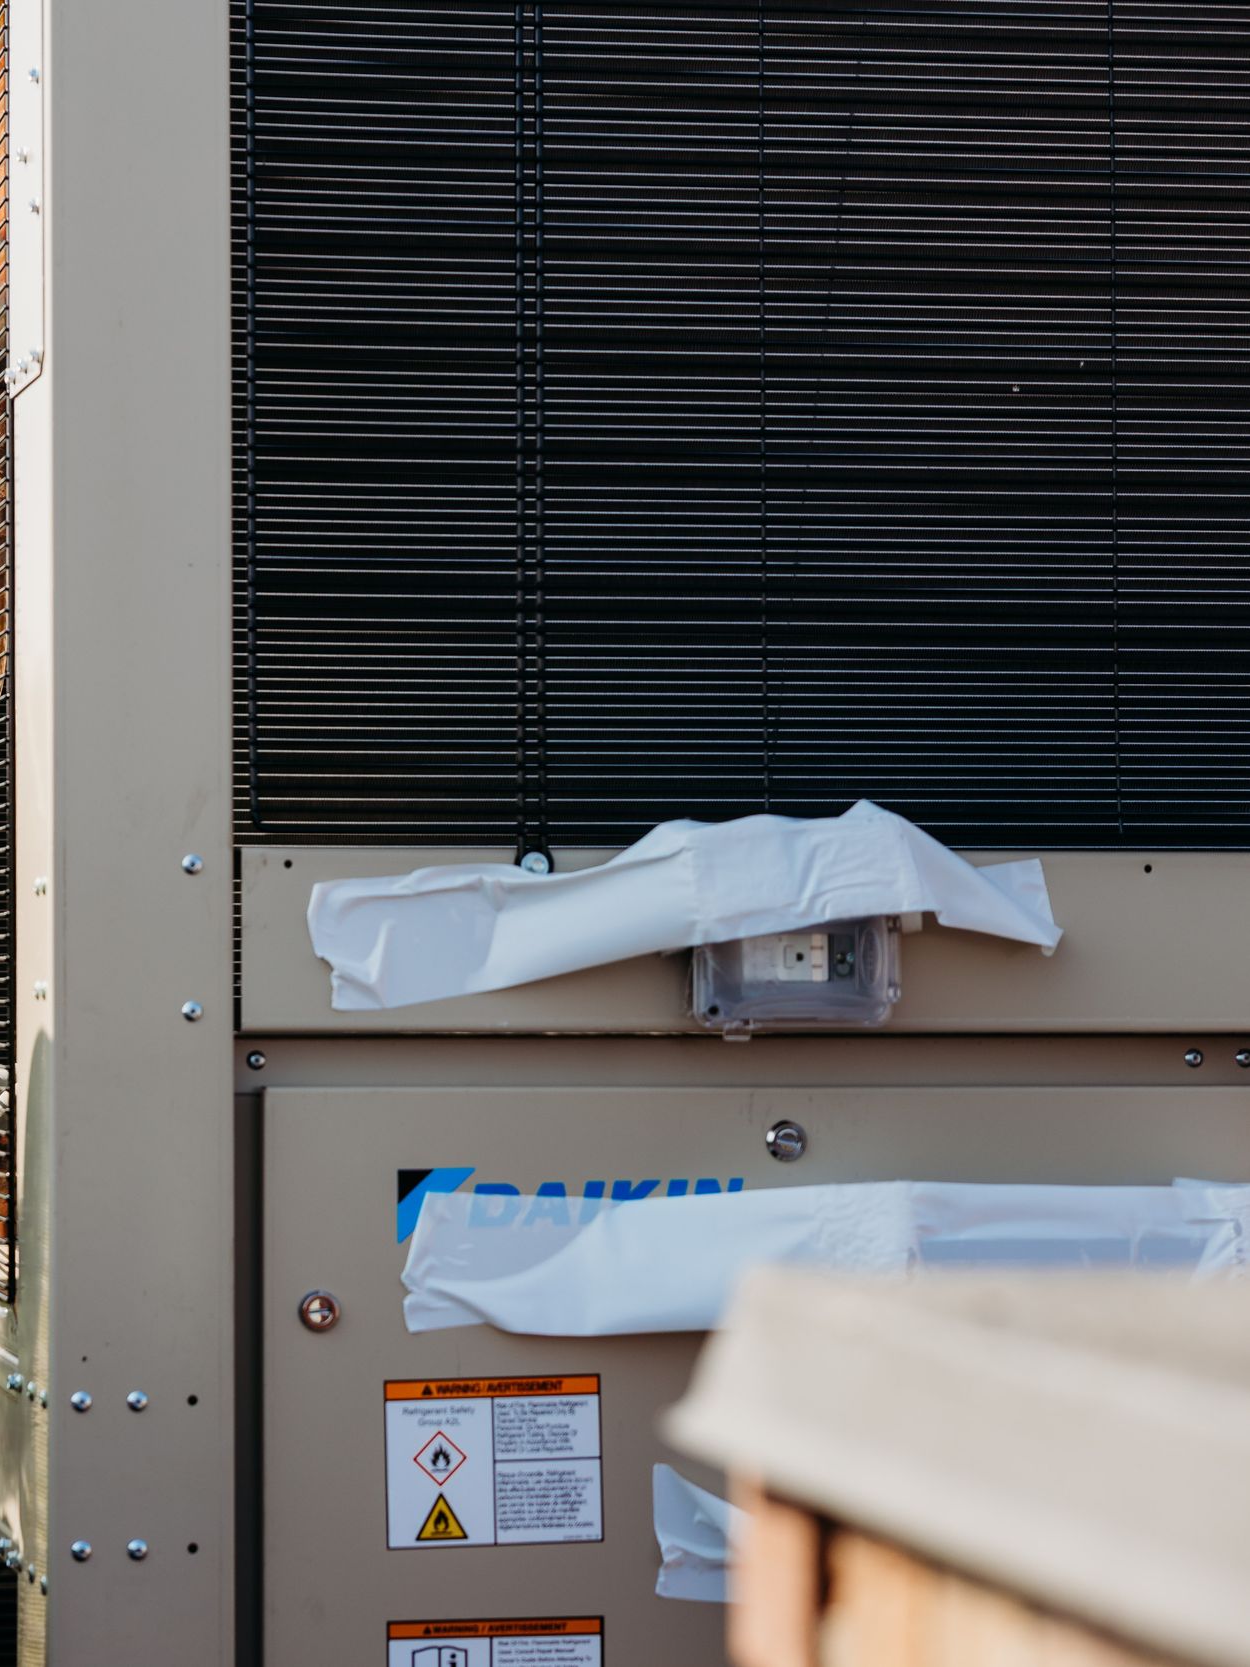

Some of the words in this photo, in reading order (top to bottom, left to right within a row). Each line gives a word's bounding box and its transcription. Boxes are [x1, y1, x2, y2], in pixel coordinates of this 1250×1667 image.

[436, 1383, 481, 1395] WARNING
[487, 1380, 564, 1393] AVERTISSEMENT
[403, 1406, 448, 1417] Refrigerant
[449, 1406, 476, 1416] Safety
[418, 1418, 444, 1427] Group
[433, 1624, 479, 1634] WARNING
[488, 1622, 568, 1633] AVERTISSEMENT
